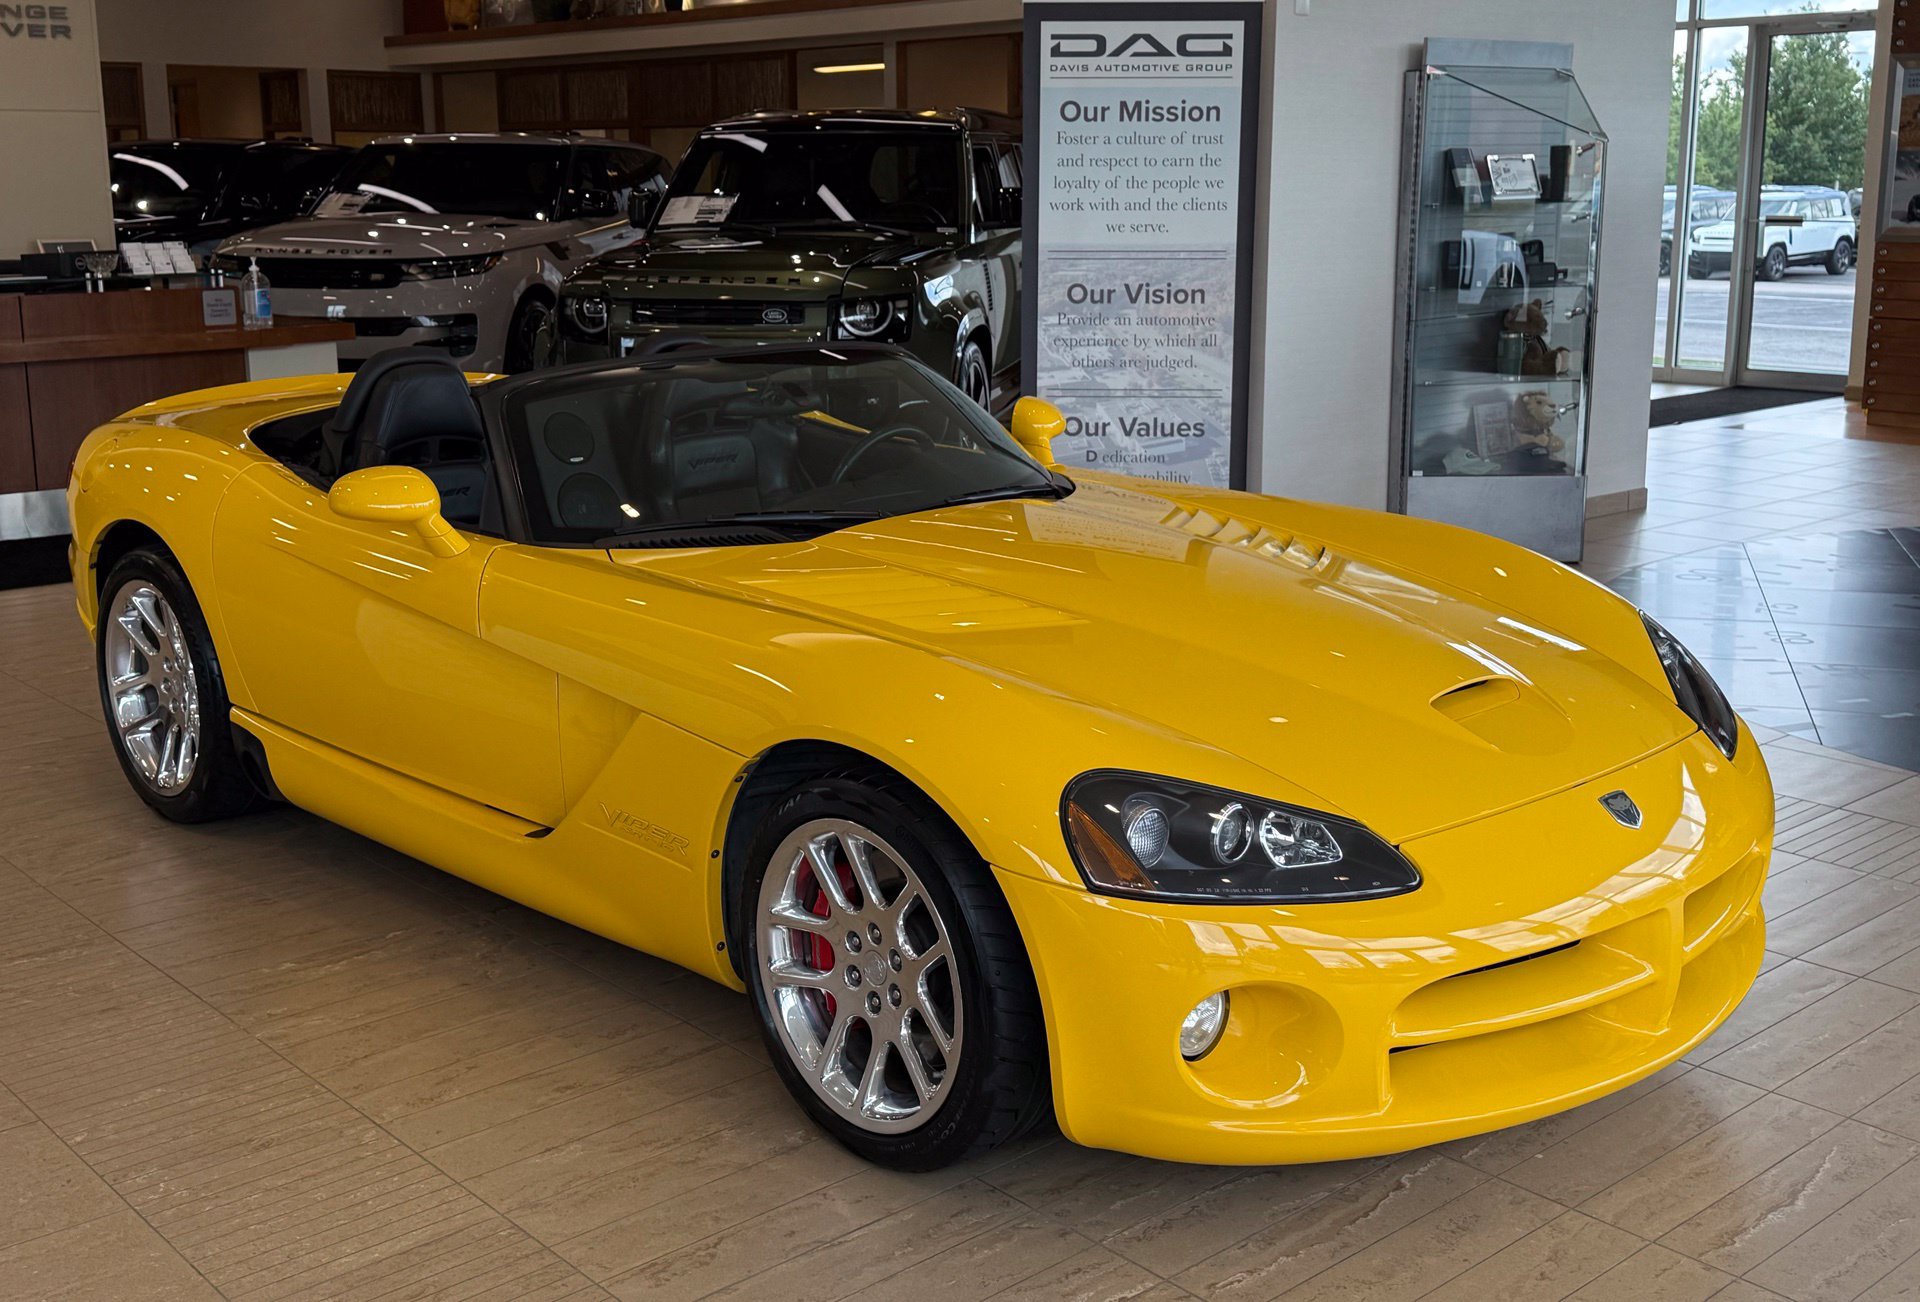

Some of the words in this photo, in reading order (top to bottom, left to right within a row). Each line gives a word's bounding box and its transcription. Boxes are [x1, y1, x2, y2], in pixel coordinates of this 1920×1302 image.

[1050, 33, 1233, 57] DAG
[1060, 100, 1110, 122] Our
[1119, 100, 1221, 122] Mission
[1056, 131, 1099, 144] Foster
[1103, 136, 1111, 144] a
[1116, 132, 1166, 144] culture
[1171, 131, 1187, 144] of
[1192, 133, 1224, 144] trust
[1057, 154, 1084, 167] and
[1089, 157, 1138, 171] respect
[1144, 156, 1157, 167] to
[1162, 158, 1194, 167] earn
[1200, 154, 1221, 167] the
[1054, 176, 1100, 193] loyalty
[1105, 176, 1121, 189] of
[1126, 176, 1148, 189] the
[1153, 176, 1199, 195] people
[1205, 180, 1224, 189] we
[1050, 198, 1084, 211] work
[1089, 198, 1119, 211] with
[1124, 198, 1151, 211] and
[1156, 198, 1178, 211] the
[1183, 198, 1228, 211] clients
[1106, 224, 1125, 233] we
[1130, 223, 1169, 233] serve.
[1067, 283, 1116, 304] Our
[1124, 283, 1205, 304] Vision
[1057, 313, 1109, 326] Provide
[1114, 317, 1131, 325] an
[1136, 313, 1215, 325] automotive
[1054, 335, 1128, 351] experience
[1134, 334, 1150, 351] by
[1154, 334, 1195, 347] which
[1201, 334, 1217, 347] all
[1072, 356, 1115, 368] others
[1120, 359, 1142, 368] are
[1144, 355, 1197, 371] judged.
[1064, 417, 1110, 436] Our
[1119, 416, 1205, 437] Values
[599, 801, 690, 857] VIPER
